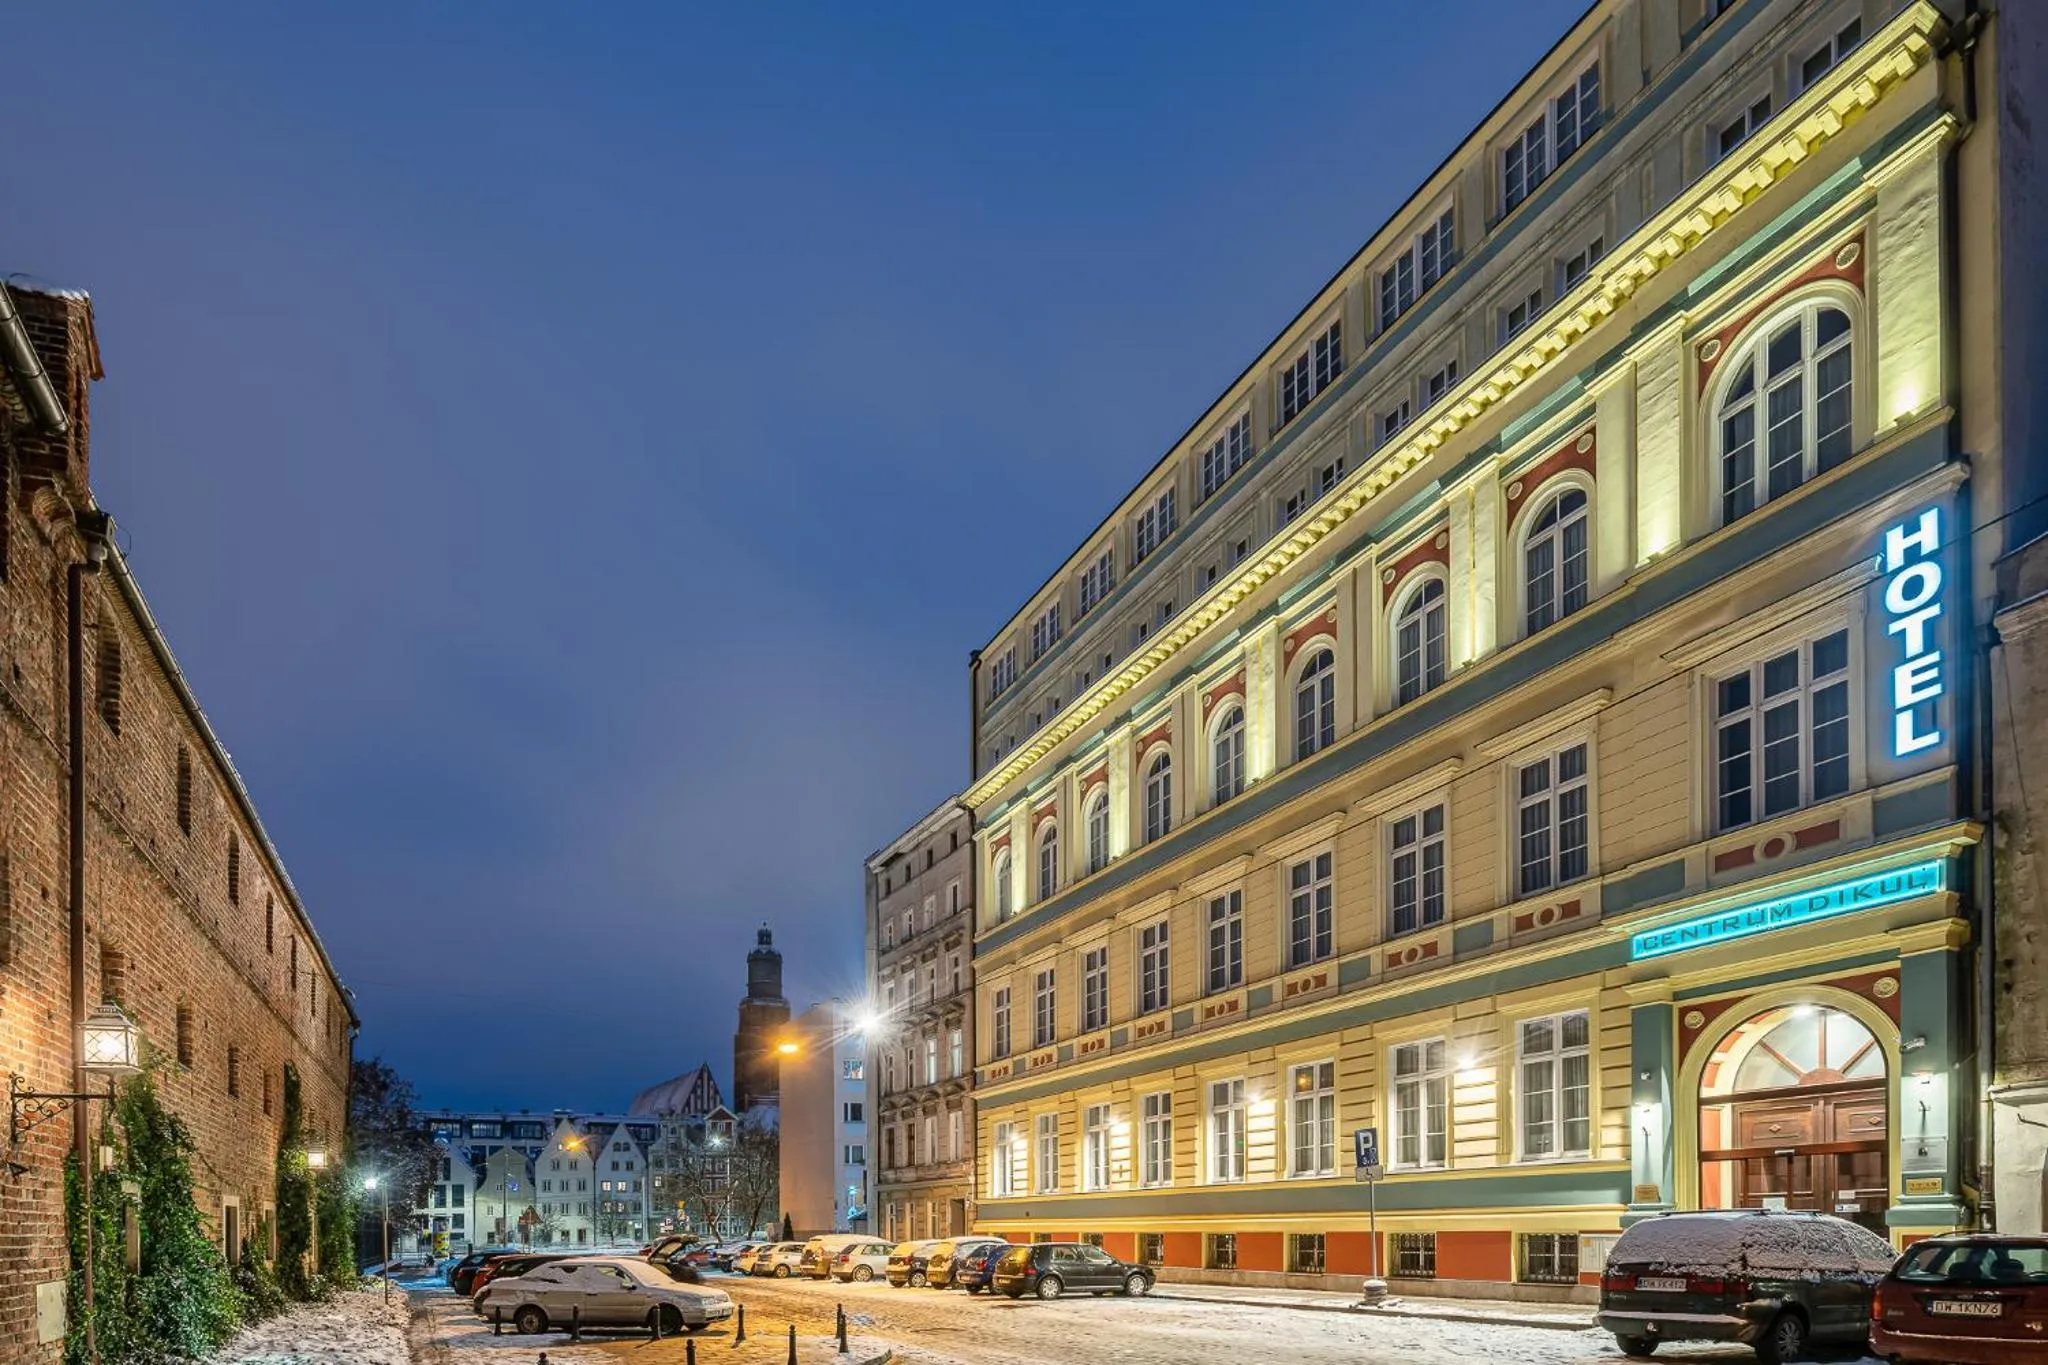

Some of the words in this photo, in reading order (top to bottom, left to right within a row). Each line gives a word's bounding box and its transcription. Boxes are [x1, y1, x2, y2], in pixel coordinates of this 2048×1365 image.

[1885, 507, 1942, 756] HOTEL
[1643, 904, 1792, 950] CENTRUM
[1808, 872, 1928, 912] DIKUL
[1360, 1132, 1373, 1155] P
